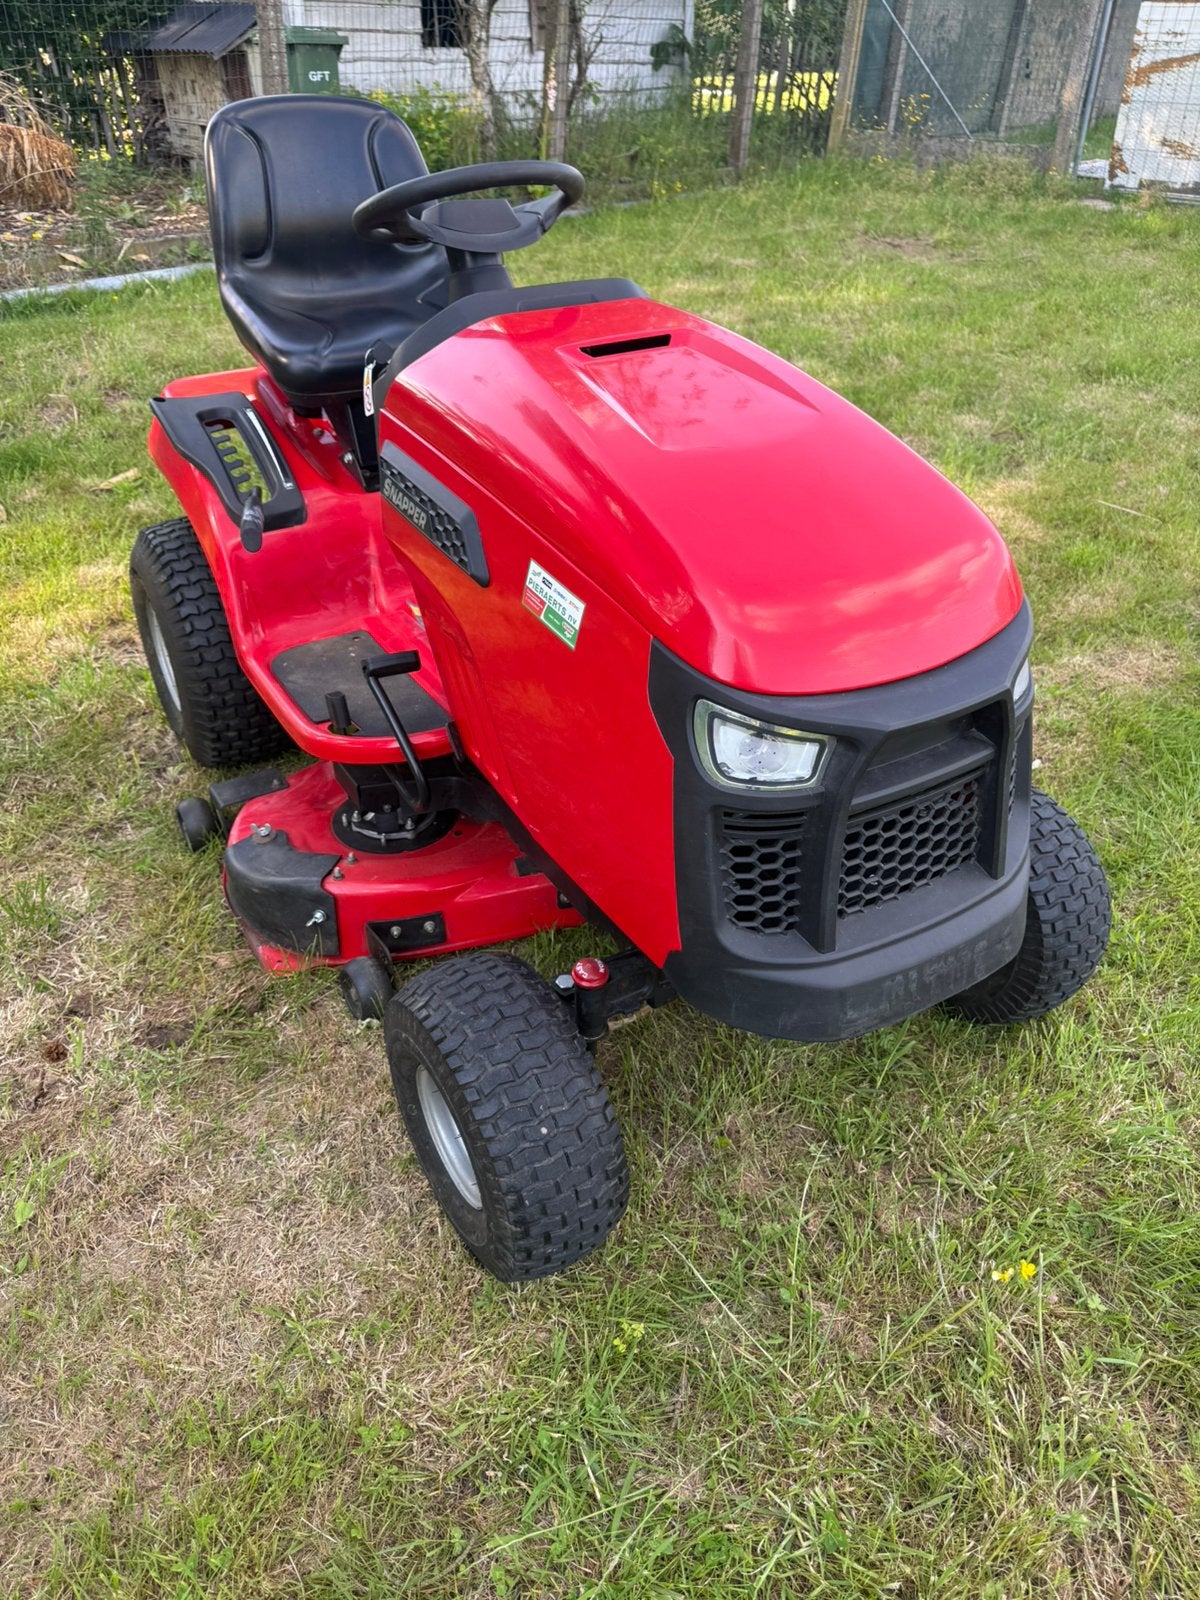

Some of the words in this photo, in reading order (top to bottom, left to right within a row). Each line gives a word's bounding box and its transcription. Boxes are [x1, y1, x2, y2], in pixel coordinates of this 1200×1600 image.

[308, 70, 330, 81] GFT
[383, 478, 427, 530] SNAPPER
[528, 577, 566, 616] PIERAERTS
